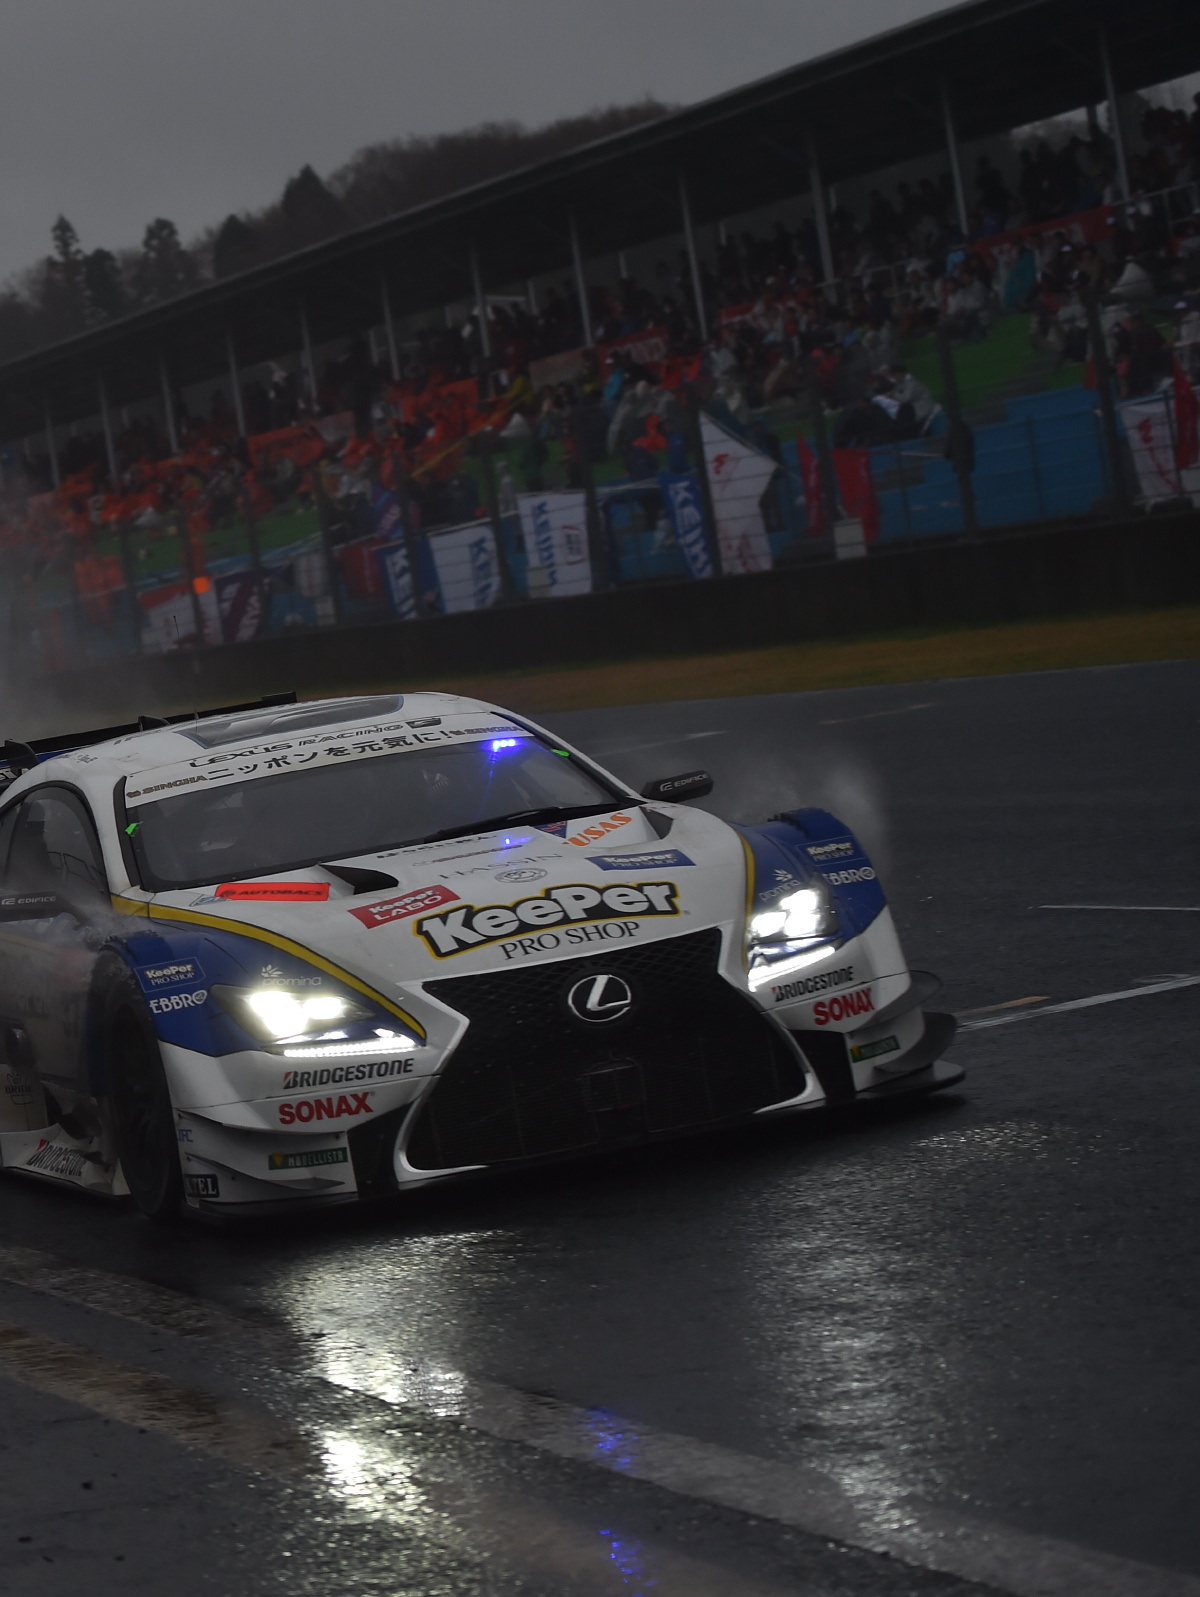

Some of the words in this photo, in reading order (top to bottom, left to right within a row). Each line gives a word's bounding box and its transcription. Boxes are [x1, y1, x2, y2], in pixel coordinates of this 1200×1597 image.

[189, 742, 293, 768] LEXUS
[299, 725, 403, 746] RACING
[143, 774, 209, 796] SINGHA
[17, 896, 57, 904] EDIFICE
[368, 889, 436, 914] KeePer
[373, 895, 443, 921] LABO
[418, 883, 676, 957] KeePer
[499, 933, 560, 960] PRO
[564, 921, 640, 945] SHOP
[145, 963, 194, 979] KeePer
[151, 975, 169, 986] PRO
[170, 972, 195, 983] SHOP
[771, 966, 854, 1002] BRIDGESTONE
[150, 989, 208, 1014] EBBRO
[814, 988, 875, 1025] SONAX
[283, 1058, 414, 1090] BRIDGESTONE
[278, 1092, 373, 1125] SONAX
